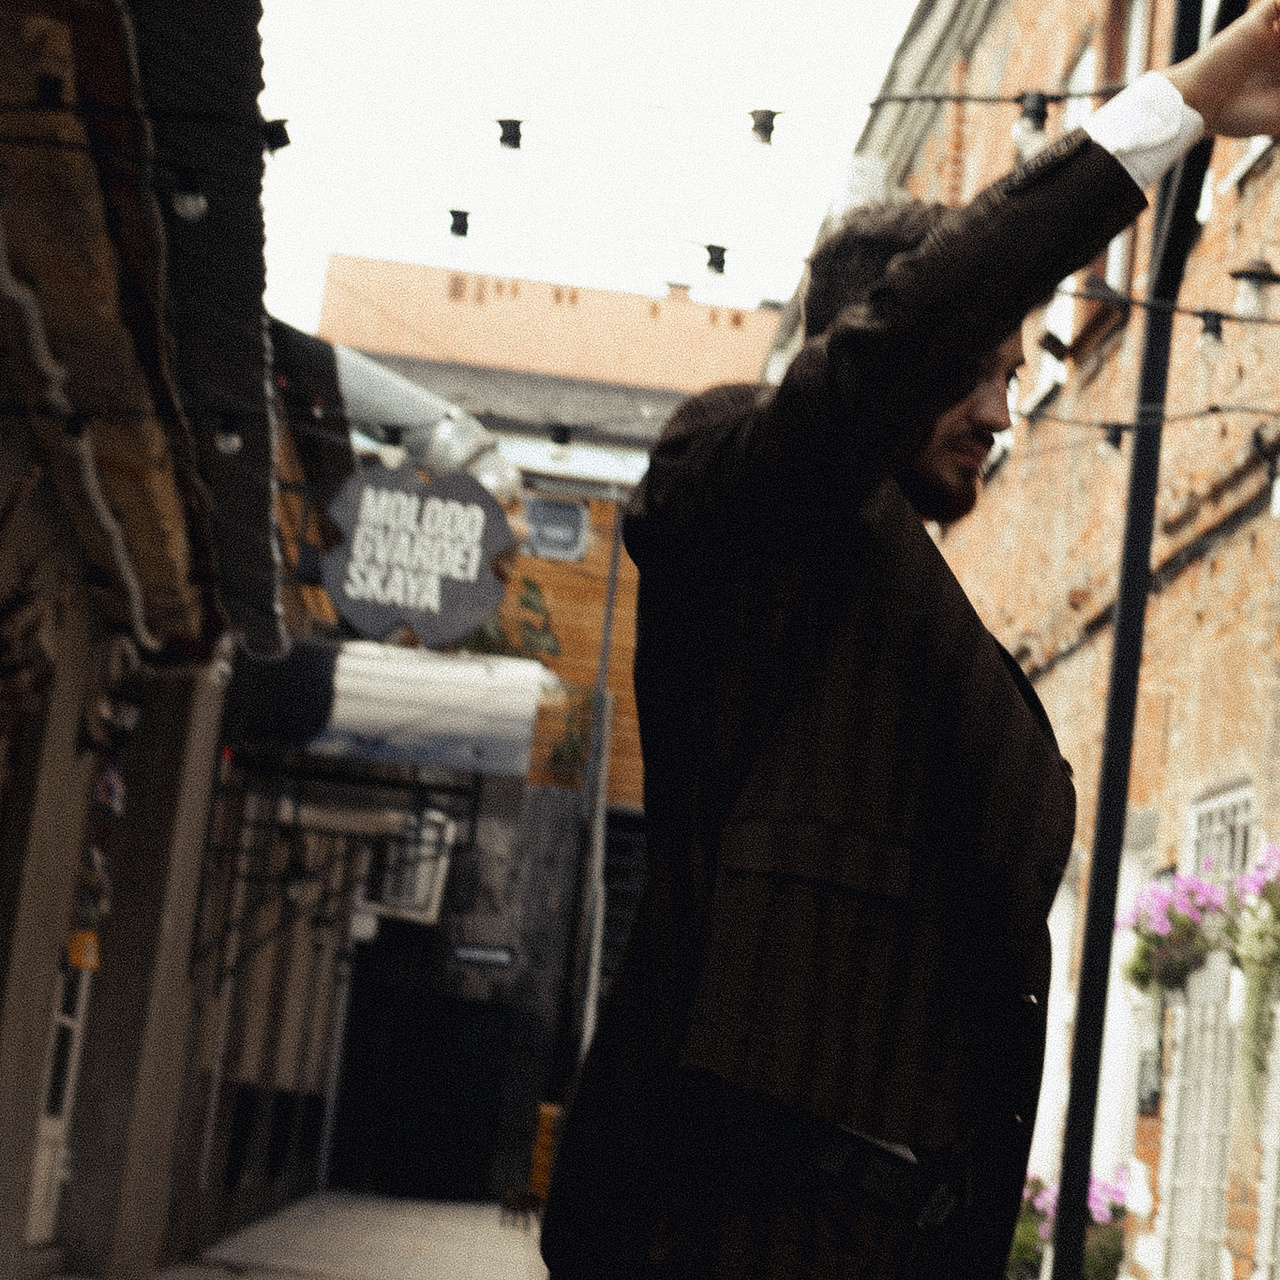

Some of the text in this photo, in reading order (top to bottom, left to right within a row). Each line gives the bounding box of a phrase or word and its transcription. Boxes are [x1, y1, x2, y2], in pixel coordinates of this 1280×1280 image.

[359, 485, 485, 542] MOLODO
[352, 523, 481, 582] GVARDEI
[344, 561, 441, 613] SKAYA
